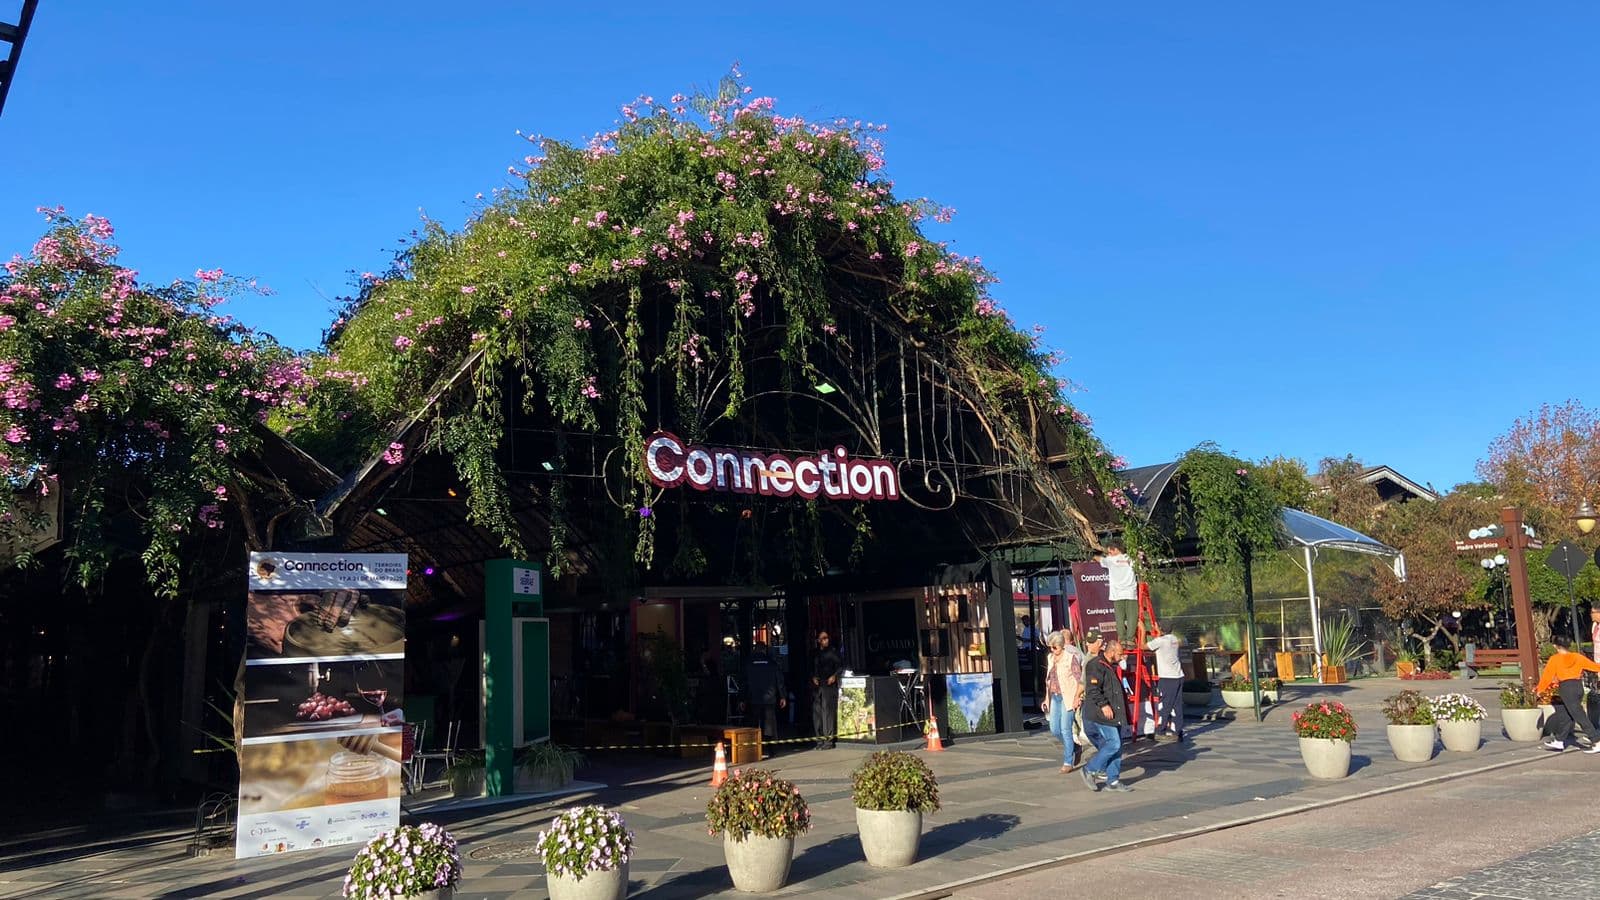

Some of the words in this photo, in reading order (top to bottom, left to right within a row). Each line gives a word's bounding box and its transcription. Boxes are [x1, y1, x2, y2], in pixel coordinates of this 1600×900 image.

[646, 437, 897, 497] Connection
[284, 559, 364, 572] Connection
[1081, 573, 1110, 582] Connectio
[868, 633, 915, 652] GRAMADO
